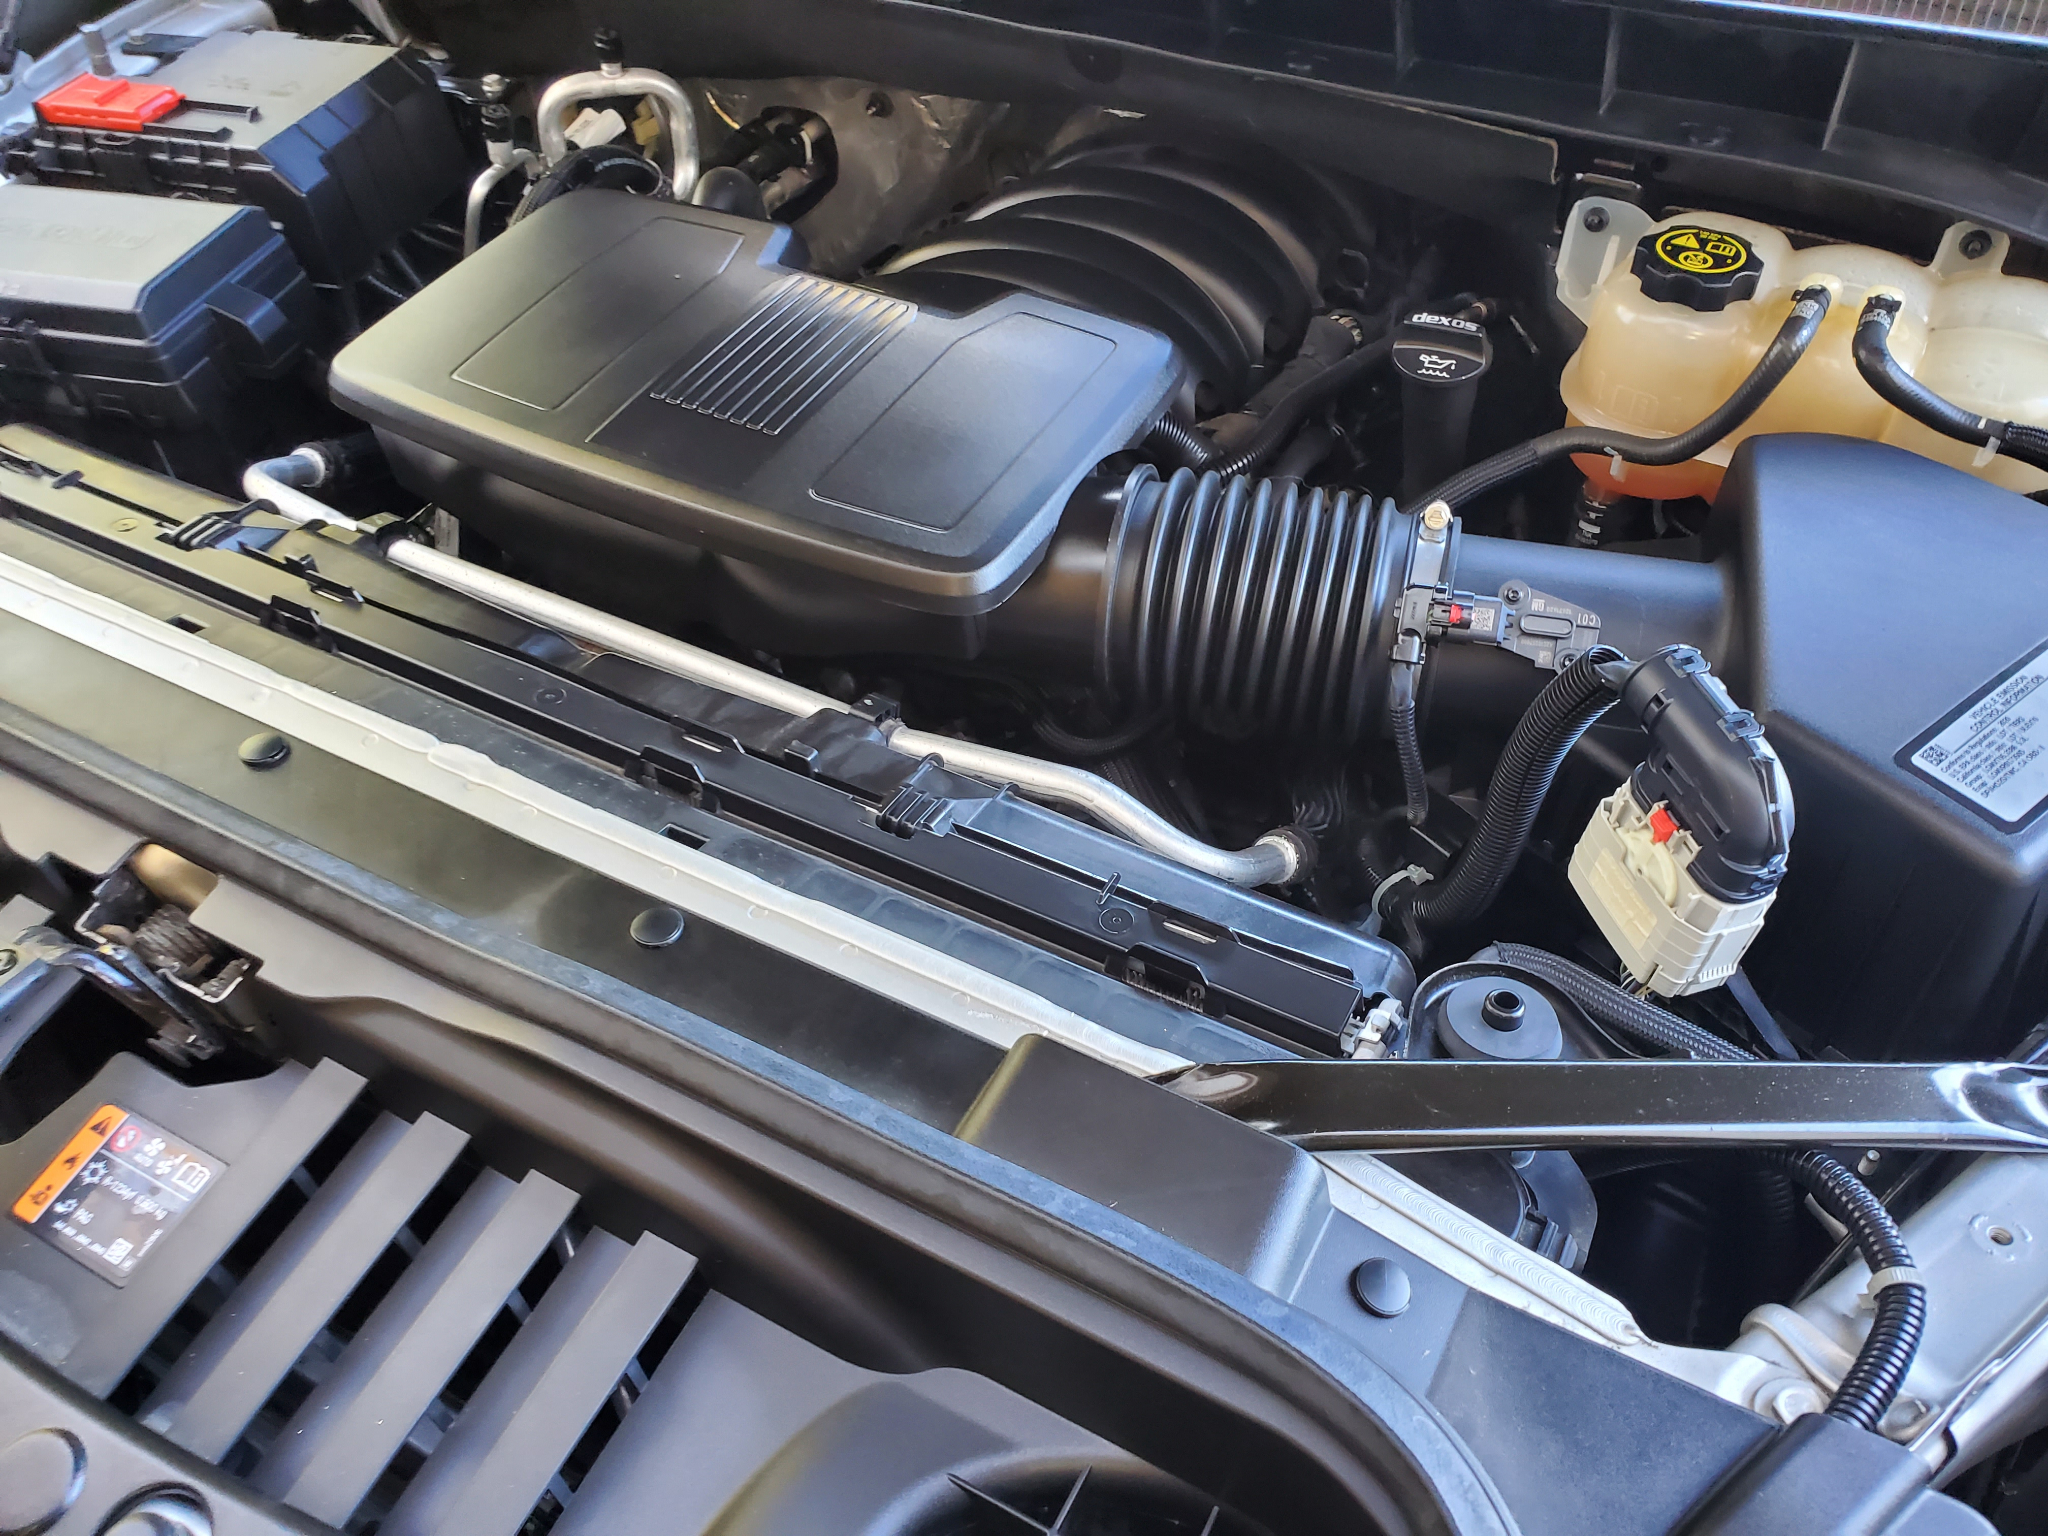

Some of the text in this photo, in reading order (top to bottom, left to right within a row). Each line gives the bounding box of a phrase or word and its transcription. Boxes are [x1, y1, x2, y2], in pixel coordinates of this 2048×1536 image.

[1412, 312, 1480, 332] dexos
[1531, 599, 1545, 612] GM
[1577, 613, 1596, 625] C01
[1970, 675, 2029, 720] VEHICLE EMISSION
[1970, 674, 2044, 732] CONTROL INFORMATION
